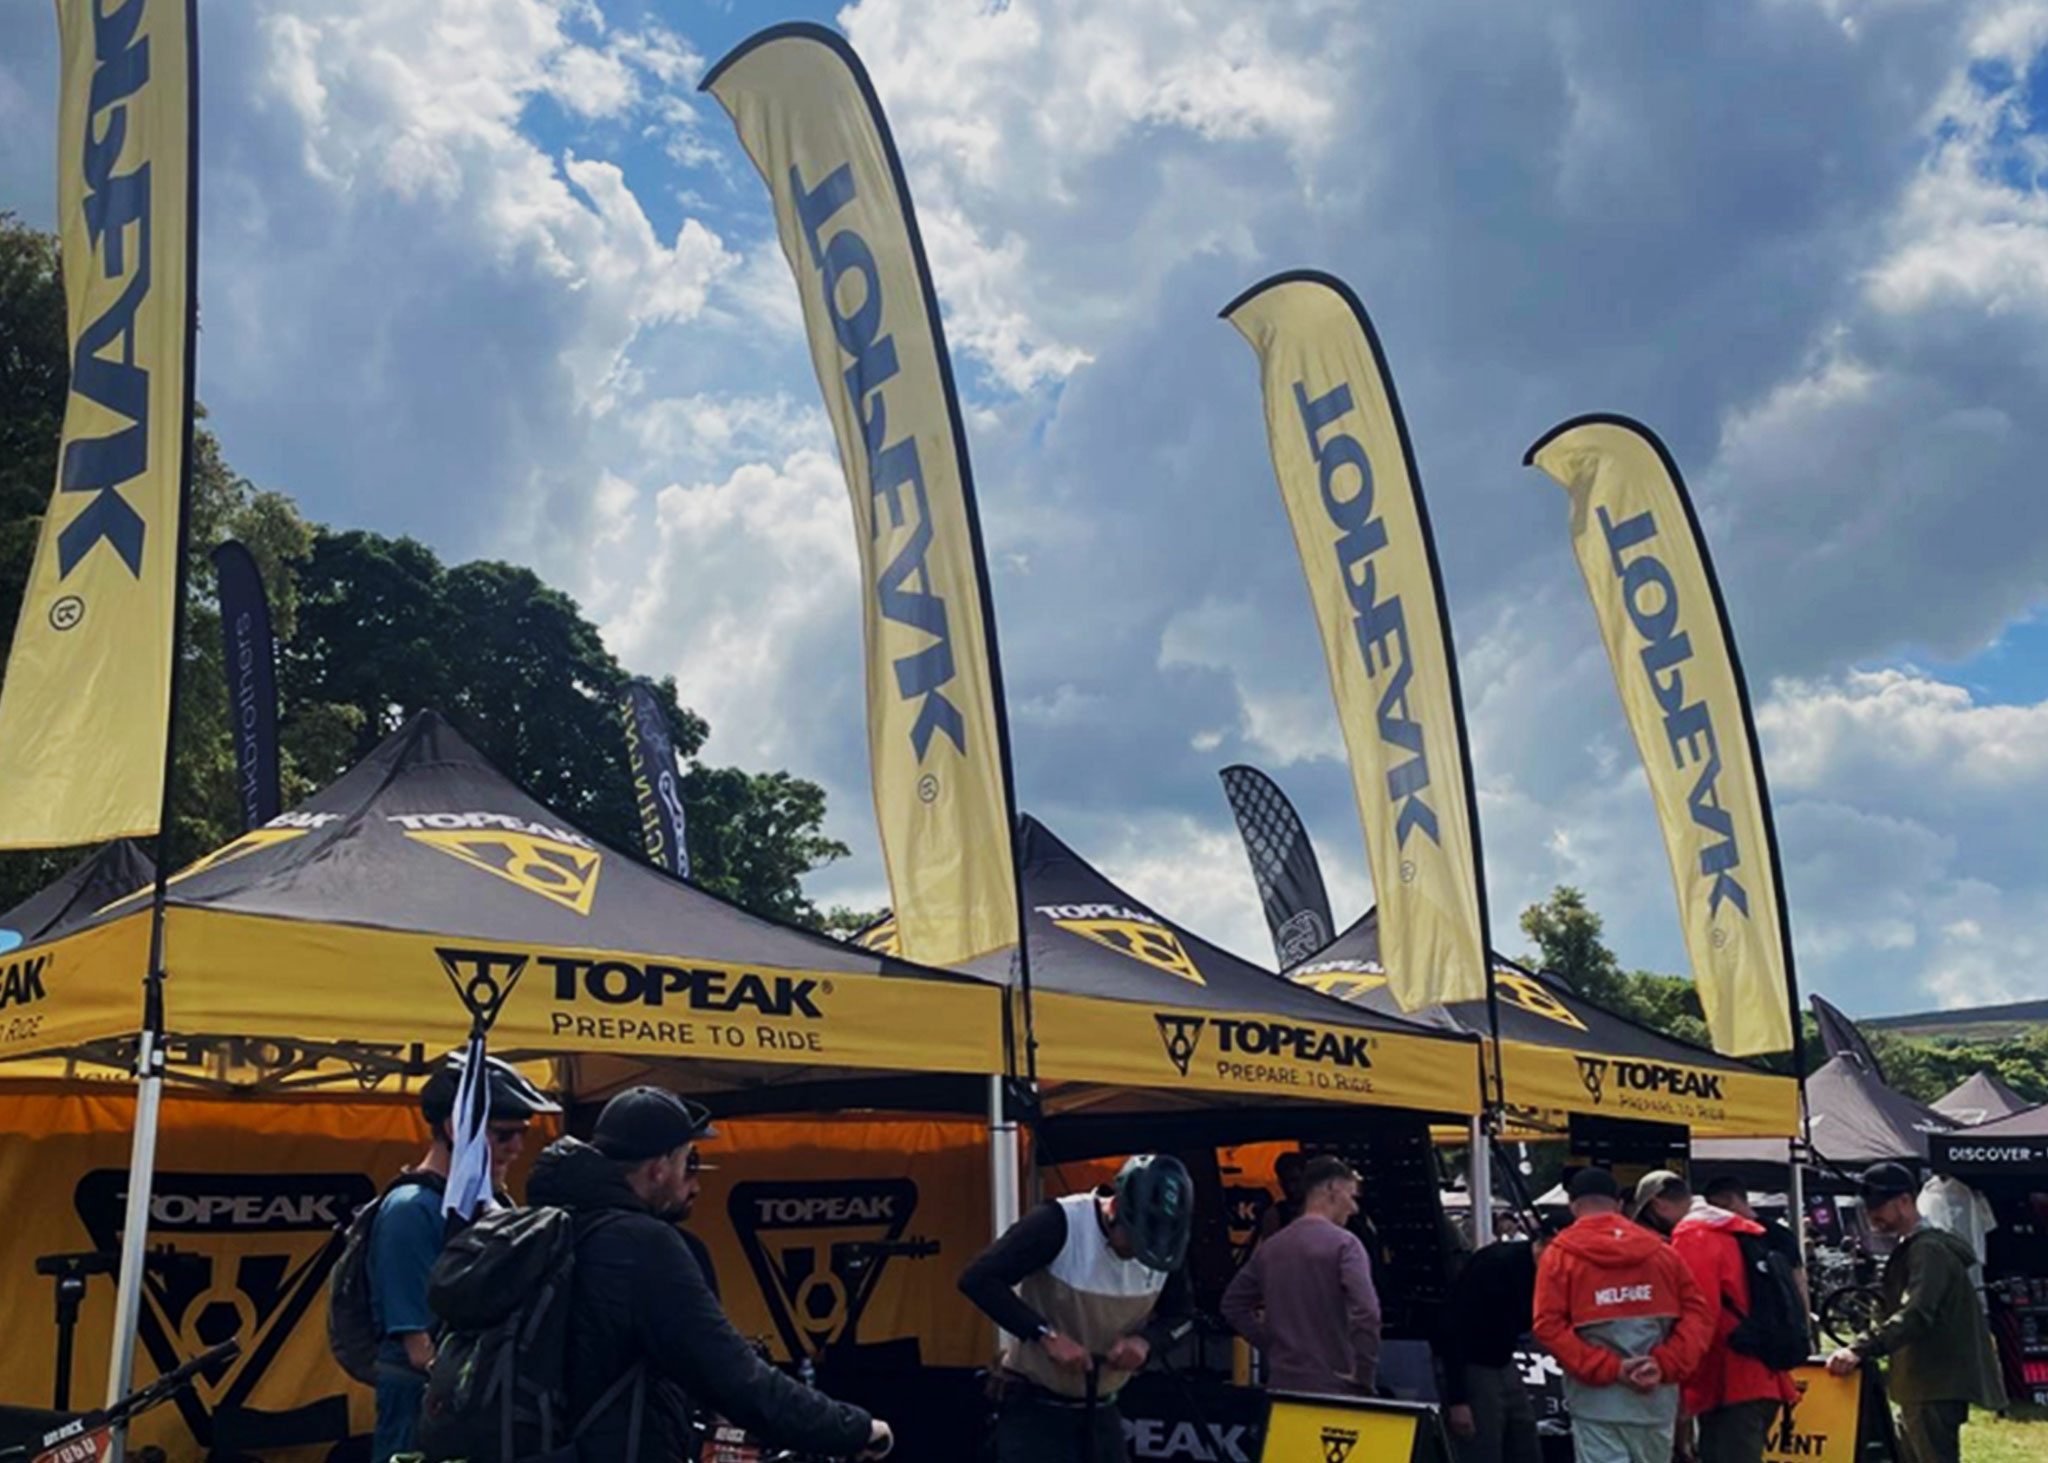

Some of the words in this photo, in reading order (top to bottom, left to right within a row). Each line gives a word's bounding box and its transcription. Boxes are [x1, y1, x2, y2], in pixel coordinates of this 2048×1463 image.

[0, 955, 46, 1010] AK
[551, 1012, 695, 1045] PREPARE
[707, 1025, 745, 1047] TO
[757, 1026, 823, 1053] RIDE
[1209, 1018, 1372, 1069] TOPEAK
[1216, 1060, 1299, 1086] PREPARE
[1611, 1060, 1723, 1100] TOPEAK
[1949, 1146, 2031, 1162] DISCOVER
[754, 1195, 894, 1224] TOPEAK
